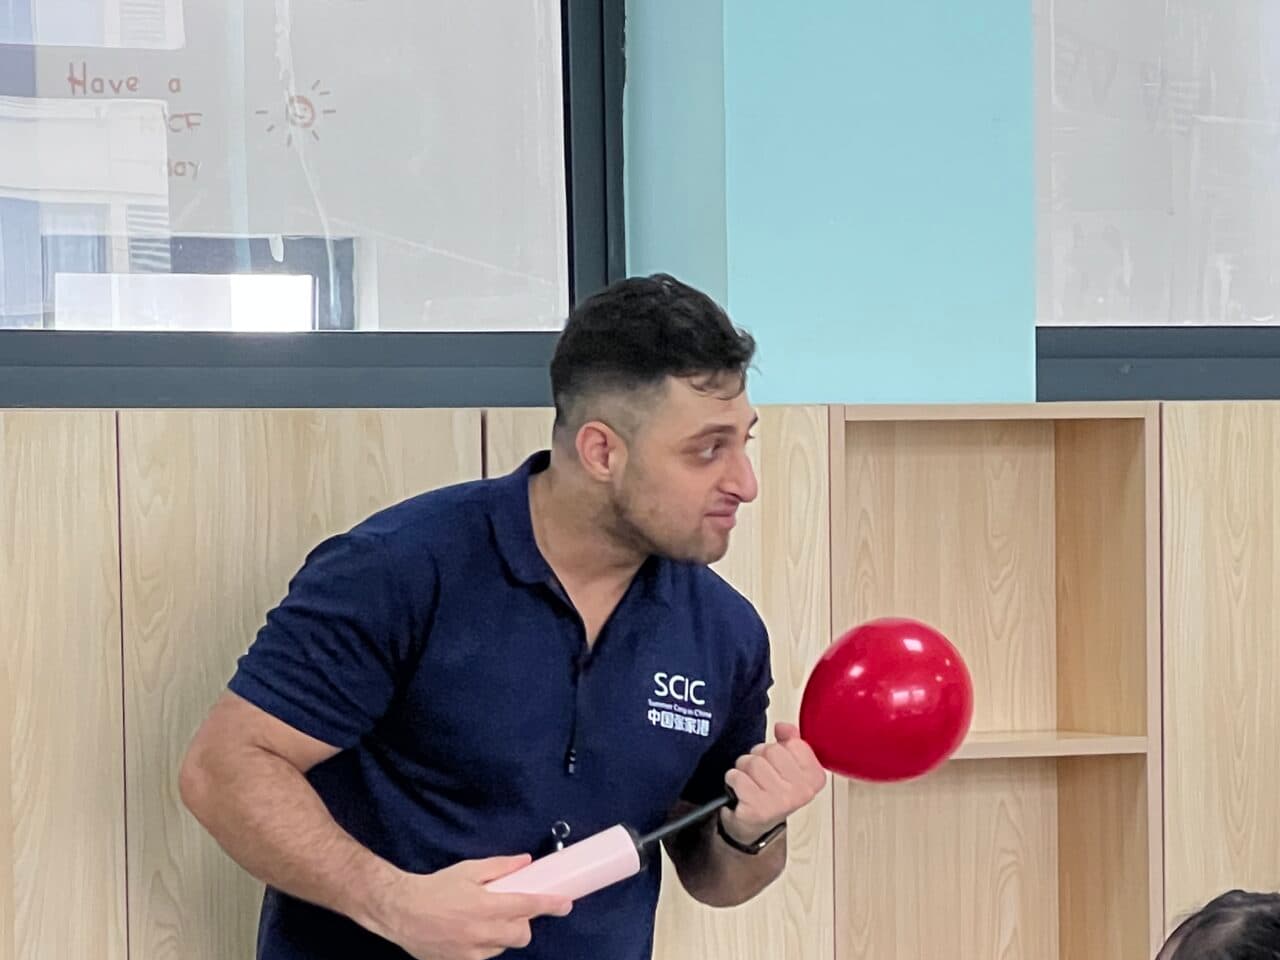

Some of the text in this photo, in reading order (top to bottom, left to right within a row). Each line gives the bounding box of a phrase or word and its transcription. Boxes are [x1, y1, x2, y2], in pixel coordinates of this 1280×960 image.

[67, 62, 181, 96] Have a
[654, 672, 706, 705] SCIC
